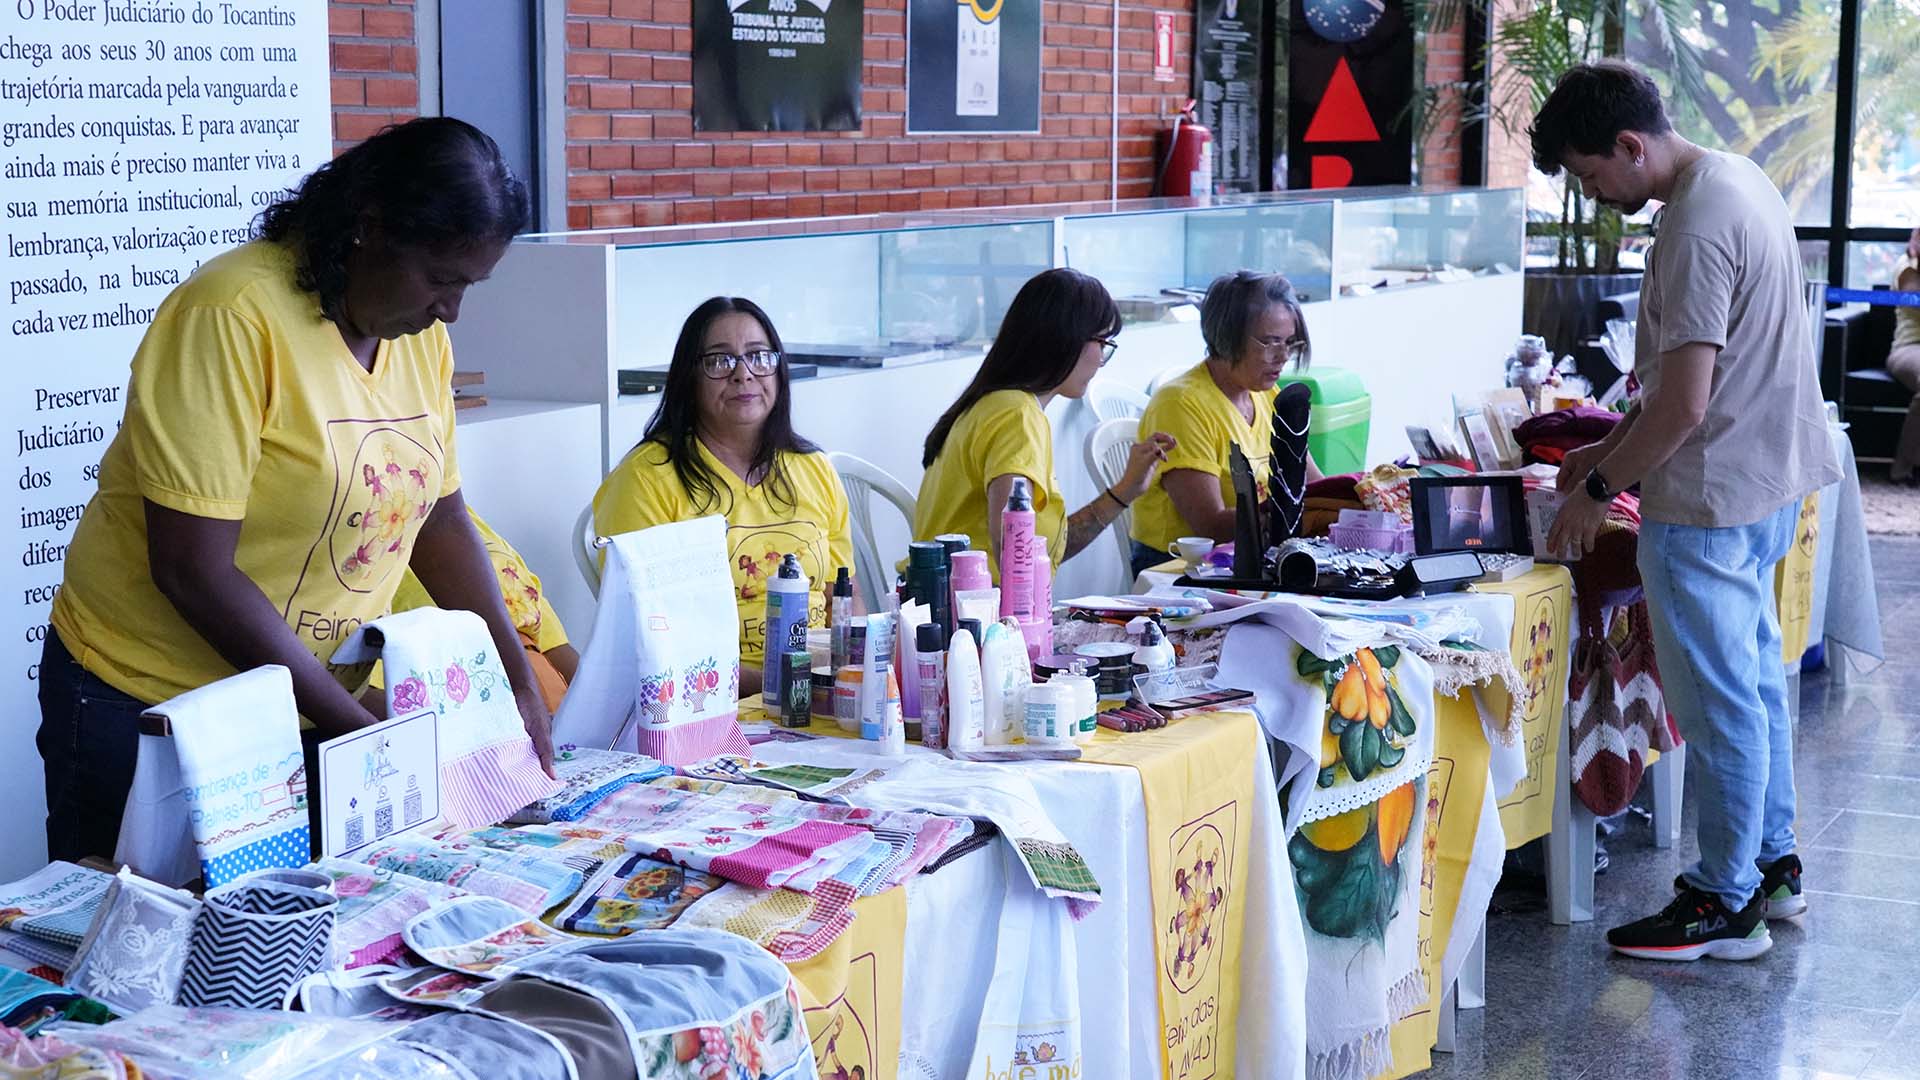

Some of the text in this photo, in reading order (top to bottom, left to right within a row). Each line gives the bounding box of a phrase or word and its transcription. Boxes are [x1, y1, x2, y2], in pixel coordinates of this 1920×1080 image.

[43, 0, 96, 21] Poder
[104, 0, 186, 26] Judiciário
[192, 1, 213, 24] do
[219, 3, 296, 26] Tocantins
[732, 12, 825, 32] TRIBUNAL DE JUSTIÇA
[732, 27, 825, 44] ESTADO DO TOCANTINS
[0, 36, 297, 67] chega aos seus 30 anos com uma
[1, 76, 298, 107] trajetória marcada pela vanguarda e
[3, 114, 300, 147] grandes conquistas. E para avançar
[4, 149, 301, 181] ainda mais é preciso manter viva a
[7, 200, 37, 219] sua
[48, 190, 129, 217] memória
[138, 185, 243, 213] institucional,
[8, 231, 109, 260] lembrança,
[112, 225, 206, 253] valorização
[210, 229, 218, 244] e
[10, 269, 87, 304] passado,
[99, 274, 120, 290] na
[132, 265, 180, 288] busca
[12, 302, 155, 336] cada vez melhor
[35, 385, 120, 411] Preservar
[17, 420, 104, 456] Judiciário
[19, 466, 51, 490] dos
[21, 503, 86, 531] imagen
[1686, 914, 1728, 938] FILA
